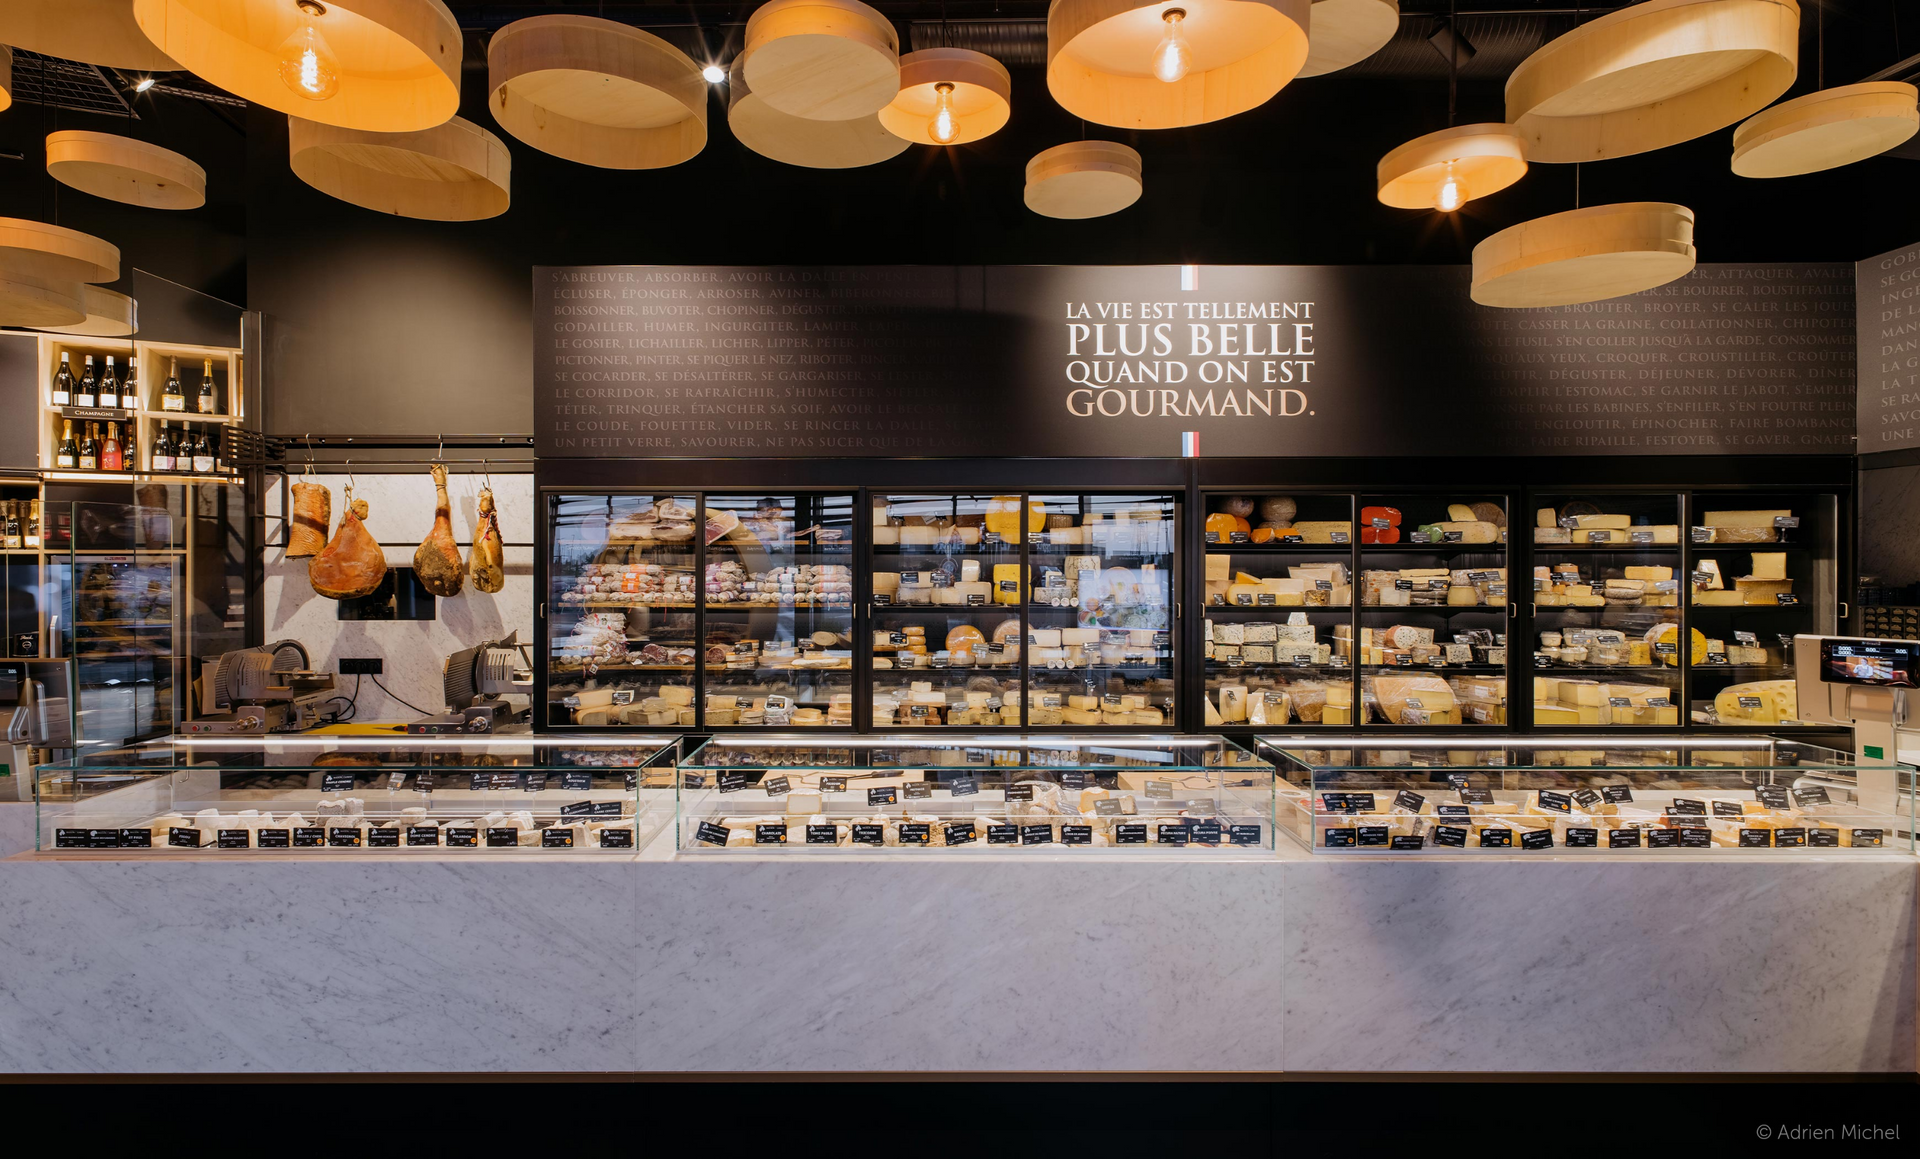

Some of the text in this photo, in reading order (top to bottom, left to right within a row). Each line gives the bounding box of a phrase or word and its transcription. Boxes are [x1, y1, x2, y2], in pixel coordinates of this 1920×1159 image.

[552, 271, 639, 283] S'ABREUVER,
[645, 271, 723, 283] ABSORBER,
[728, 271, 773, 282] AVOIR
[778, 271, 797, 282] LA
[1718, 268, 1799, 282] ATTAQUER,
[1881, 275, 1895, 288] SE
[553, 286, 616, 300] ÉCLUSER,
[622, 286, 692, 300] ÉPONGER,
[697, 288, 764, 300] ARROSER,
[769, 288, 824, 300] AVINER,
[1665, 285, 1680, 296] SE
[1683, 285, 1748, 297] BOURRER,
[554, 303, 850, 317] BOISSONNER, BUVOTER, CHOPINER, DÉGUSTER,
[1066, 302, 1315, 319] LA VIE EST TELLEMENT
[1644, 302, 1709, 314] BROYER,
[1712, 302, 1727, 313] SE
[1732, 302, 1779, 313] CALER
[1785, 302, 1808, 313] LES
[1882, 308, 1901, 322] DE
[554, 321, 862, 333] GODAILLER, HUMER, INGURGITER, LAMPER,
[1518, 318, 1569, 329] CASSER
[1574, 318, 1591, 329] LA
[1596, 318, 1655, 330] GRAINE,
[1660, 318, 1777, 330] COLLATIONNER,
[1882, 321, 1920, 339] MAN
[555, 338, 568, 349] LE
[572, 338, 625, 350] GOSIER,
[629, 338, 707, 350] LICHAILLER,
[712, 338, 763, 350] LICHER,
[767, 338, 813, 350] LIPPER,
[1066, 323, 1315, 356] PLUS BELLE
[1498, 335, 1511, 346] LE
[1515, 335, 1553, 347] FUSIL,
[1556, 335, 1582, 346] S'EN
[1586, 335, 1637, 346] COLLER
[1696, 335, 1712, 346] LA
[1716, 335, 1765, 347] GARDE,
[555, 354, 632, 366] PICTONNER,
[636, 354, 684, 366] PINTER,
[687, 354, 700, 365] SE
[703, 354, 749, 367] PIQUER
[753, 354, 766, 365] LE
[769, 354, 796, 366] NEZ,
[800, 354, 857, 366] RIBOTER,
[1550, 351, 1591, 363] YEUX,
[1596, 351, 1672, 365] CROQUER,
[1678, 351, 1781, 363] CROUSTILLER,
[1549, 366, 1632, 380] DÉGUSTER,
[1639, 366, 1720, 380] DÉJEUNER,
[1727, 366, 1801, 380] DÉVORER,
[1882, 361, 1900, 373] LA
[555, 371, 568, 382] SE
[572, 371, 651, 383] COCARDER,
[654, 371, 668, 382] SE
[673, 369, 757, 383] DÉSALTÉRER,
[761, 371, 774, 382] SE
[779, 371, 866, 383] GARGARISER,
[1065, 360, 1315, 389] QUAND ON EST
[1555, 384, 1636, 396] L'ESTOMAC,
[1641, 384, 1656, 395] SE
[1661, 384, 1719, 395] GARNIR
[1723, 384, 1739, 395] LE
[1743, 384, 1789, 396] JABOT,
[1882, 378, 1900, 390] LA
[555, 385, 880, 399] LE CORRIDOR, SE RAFRAÎCHIR, S'HUMECTER,
[1066, 389, 1315, 417] GOURMAND.
[1539, 401, 1565, 412] PAR
[1568, 401, 1589, 412] LES
[1593, 401, 1652, 413] BABINES,
[1656, 401, 1724, 413] S'ENFILER,
[1729, 401, 1755, 412] S'EN
[1762, 401, 1815, 412] FOUTRE
[1881, 396, 1896, 408] SE
[554, 402, 602, 416] TÉTER,
[606, 404, 686, 418] TRINQUER,
[691, 402, 766, 415] ÉTANCHER
[769, 404, 786, 415] SA
[790, 404, 825, 416] SOIF,
[829, 404, 874, 415] AVOIR
[555, 420, 570, 431] LE
[576, 420, 633, 432] COUDE,
[640, 420, 721, 432] FOUETTER,
[727, 420, 778, 432] VIDER,
[784, 420, 799, 431] SE
[805, 420, 861, 431] RINCER
[1632, 416, 1723, 430] ÉPINOCHER,
[1729, 418, 1770, 429] FAIRE
[1576, 434, 1640, 446] RIPAILLE,
[1646, 434, 1720, 446] FESTOYER,
[1725, 434, 1740, 445] SE
[1744, 434, 1796, 446] GAVER,
[1882, 428, 1914, 441] UNE
[555, 437, 576, 448] UN
[582, 437, 622, 448] PETIT
[628, 437, 676, 449] VERRE,
[681, 437, 760, 449] SAVOURER,
[766, 437, 785, 448] NE
[791, 437, 814, 448] PAS
[819, 437, 864, 448] SUCER
